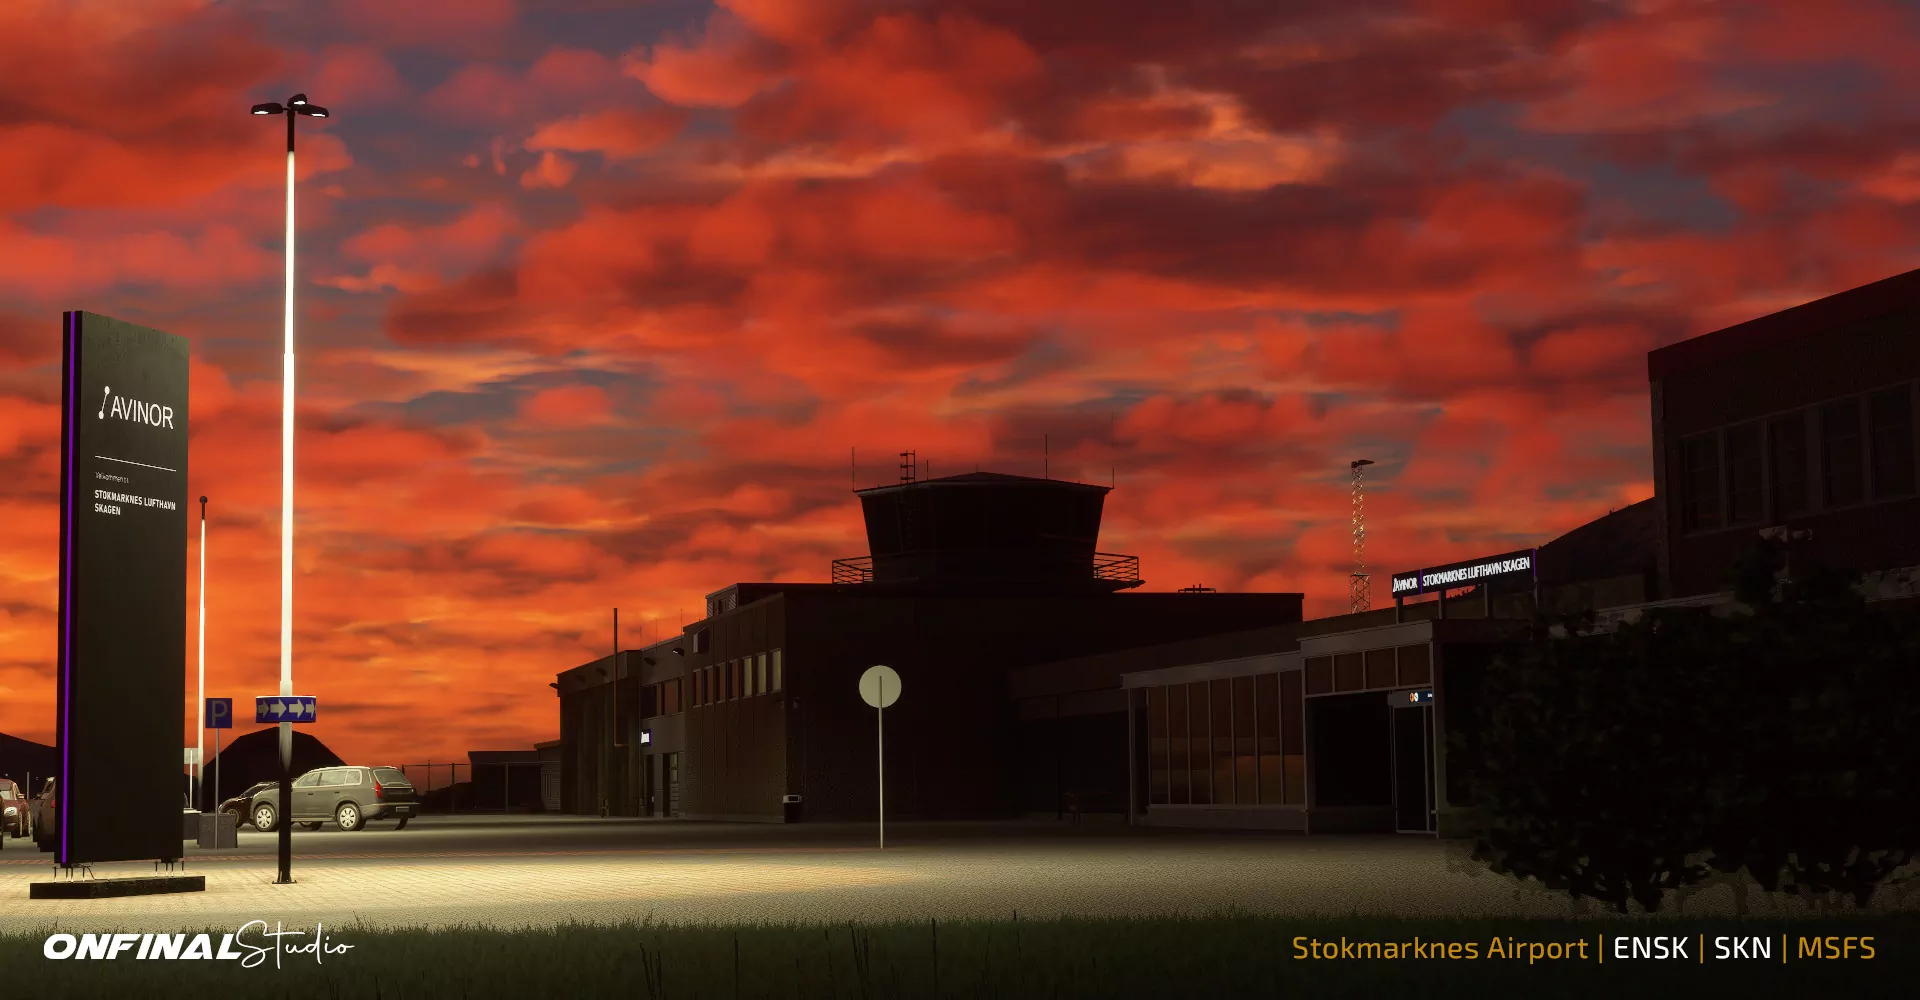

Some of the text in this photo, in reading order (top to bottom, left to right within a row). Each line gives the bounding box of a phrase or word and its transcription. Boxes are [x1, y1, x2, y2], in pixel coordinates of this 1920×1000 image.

[110, 395, 174, 429] AVINOR
[94, 489, 176, 511] STOKMARKNES LUFTHAVN
[94, 502, 121, 516] SKAGEN
[1395, 556, 1530, 591] AVINOR STOKMARKNES LUFTHAVN SKAGEN
[211, 700, 228, 727] P
